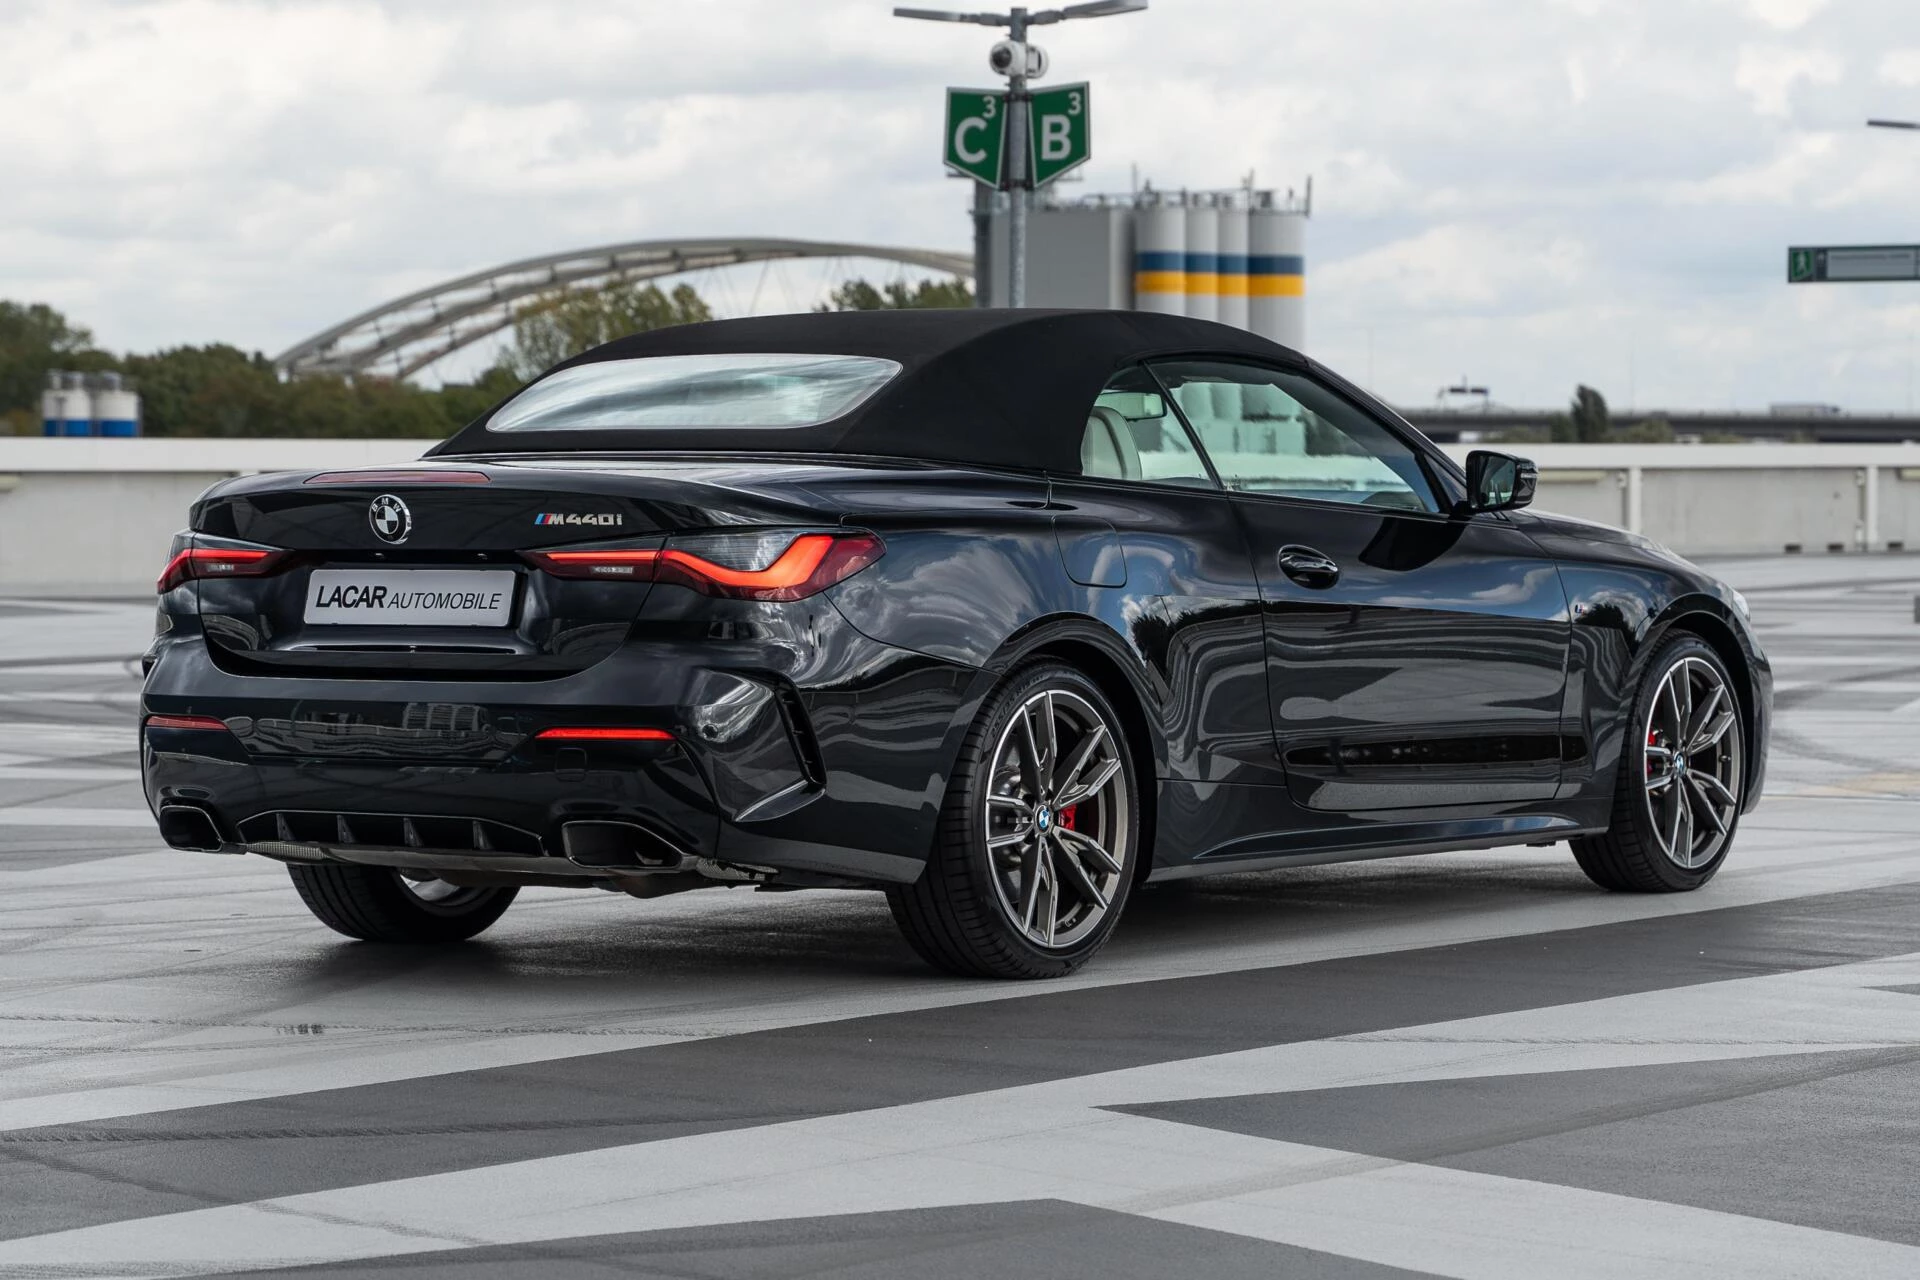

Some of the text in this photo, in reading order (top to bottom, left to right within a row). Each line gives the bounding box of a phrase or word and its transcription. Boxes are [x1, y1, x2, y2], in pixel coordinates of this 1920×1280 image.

[982, 95, 996, 119] 3
[1068, 92, 1082, 115] 3
[954, 116, 988, 164] C
[1041, 114, 1072, 161] B
[371, 497, 402, 512] BMW
[547, 513, 623, 526] M440i
[315, 585, 502, 610] LACAR AUTOMOBILE
